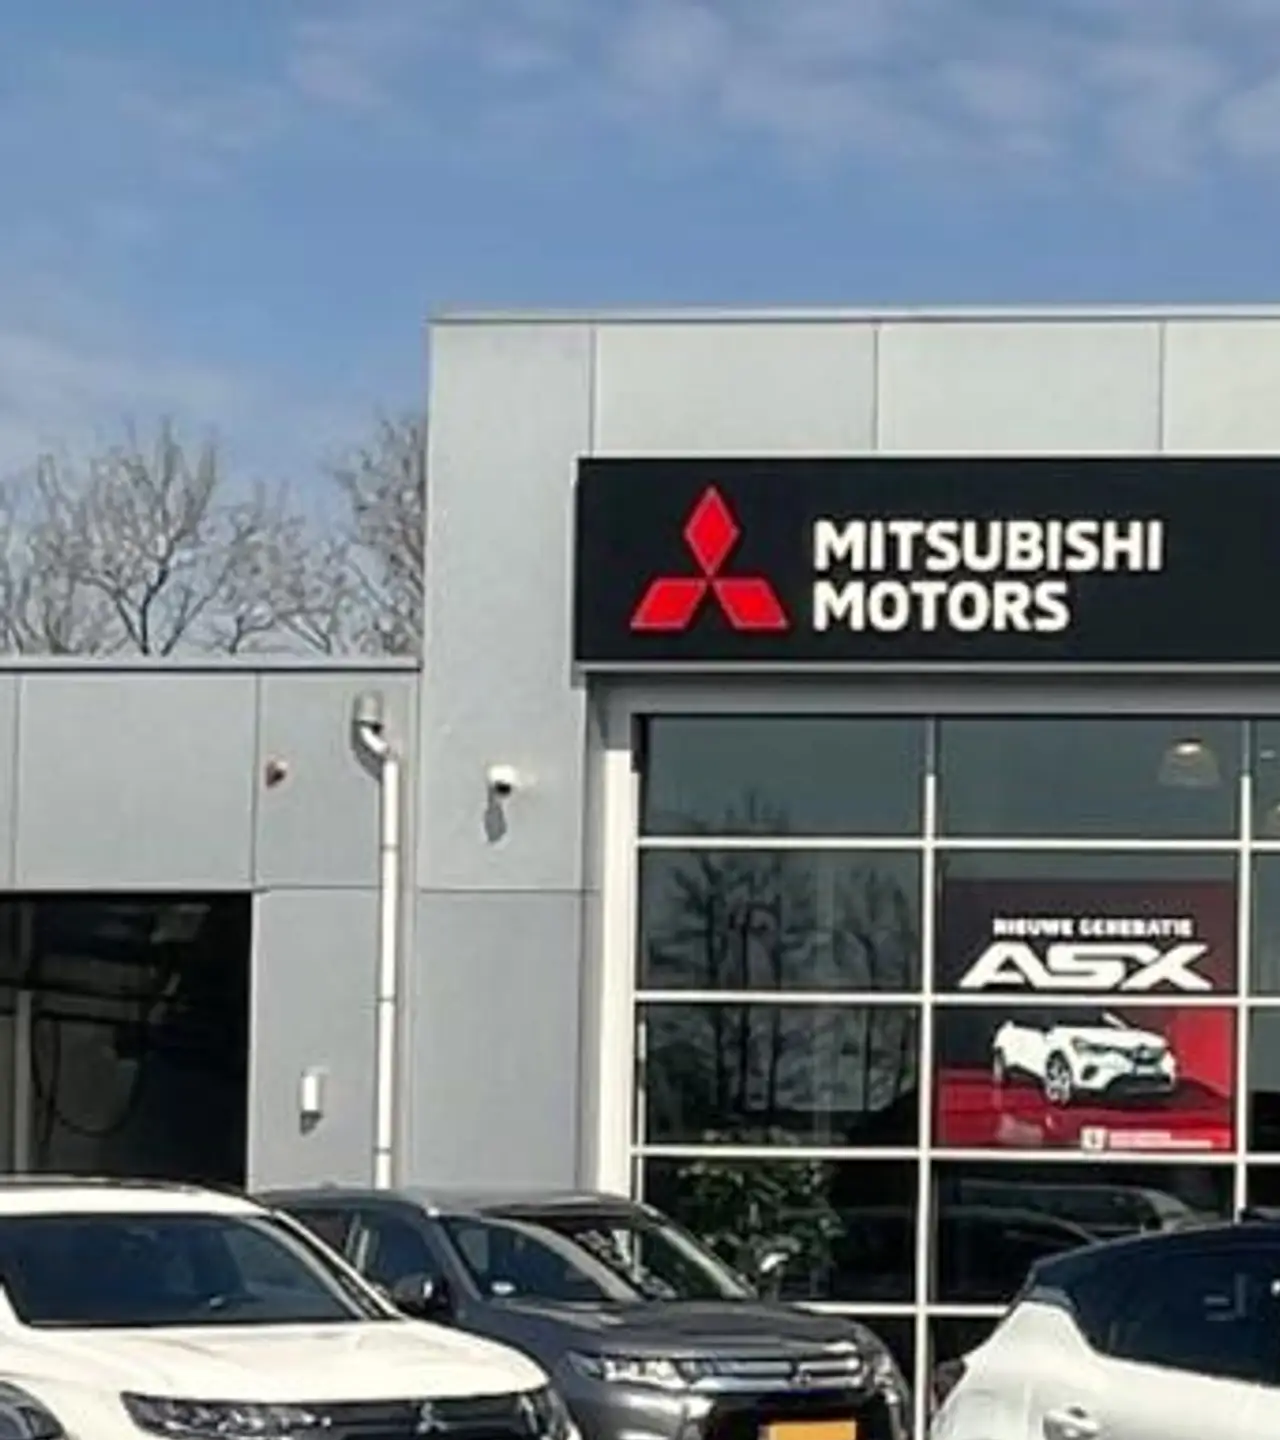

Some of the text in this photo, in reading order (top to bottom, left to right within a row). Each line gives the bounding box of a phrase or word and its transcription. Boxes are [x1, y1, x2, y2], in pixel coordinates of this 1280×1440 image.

[813, 520, 1164, 571] MITSUBISHI
[813, 580, 1070, 631] MOTORS
[958, 942, 1214, 992] ASX
